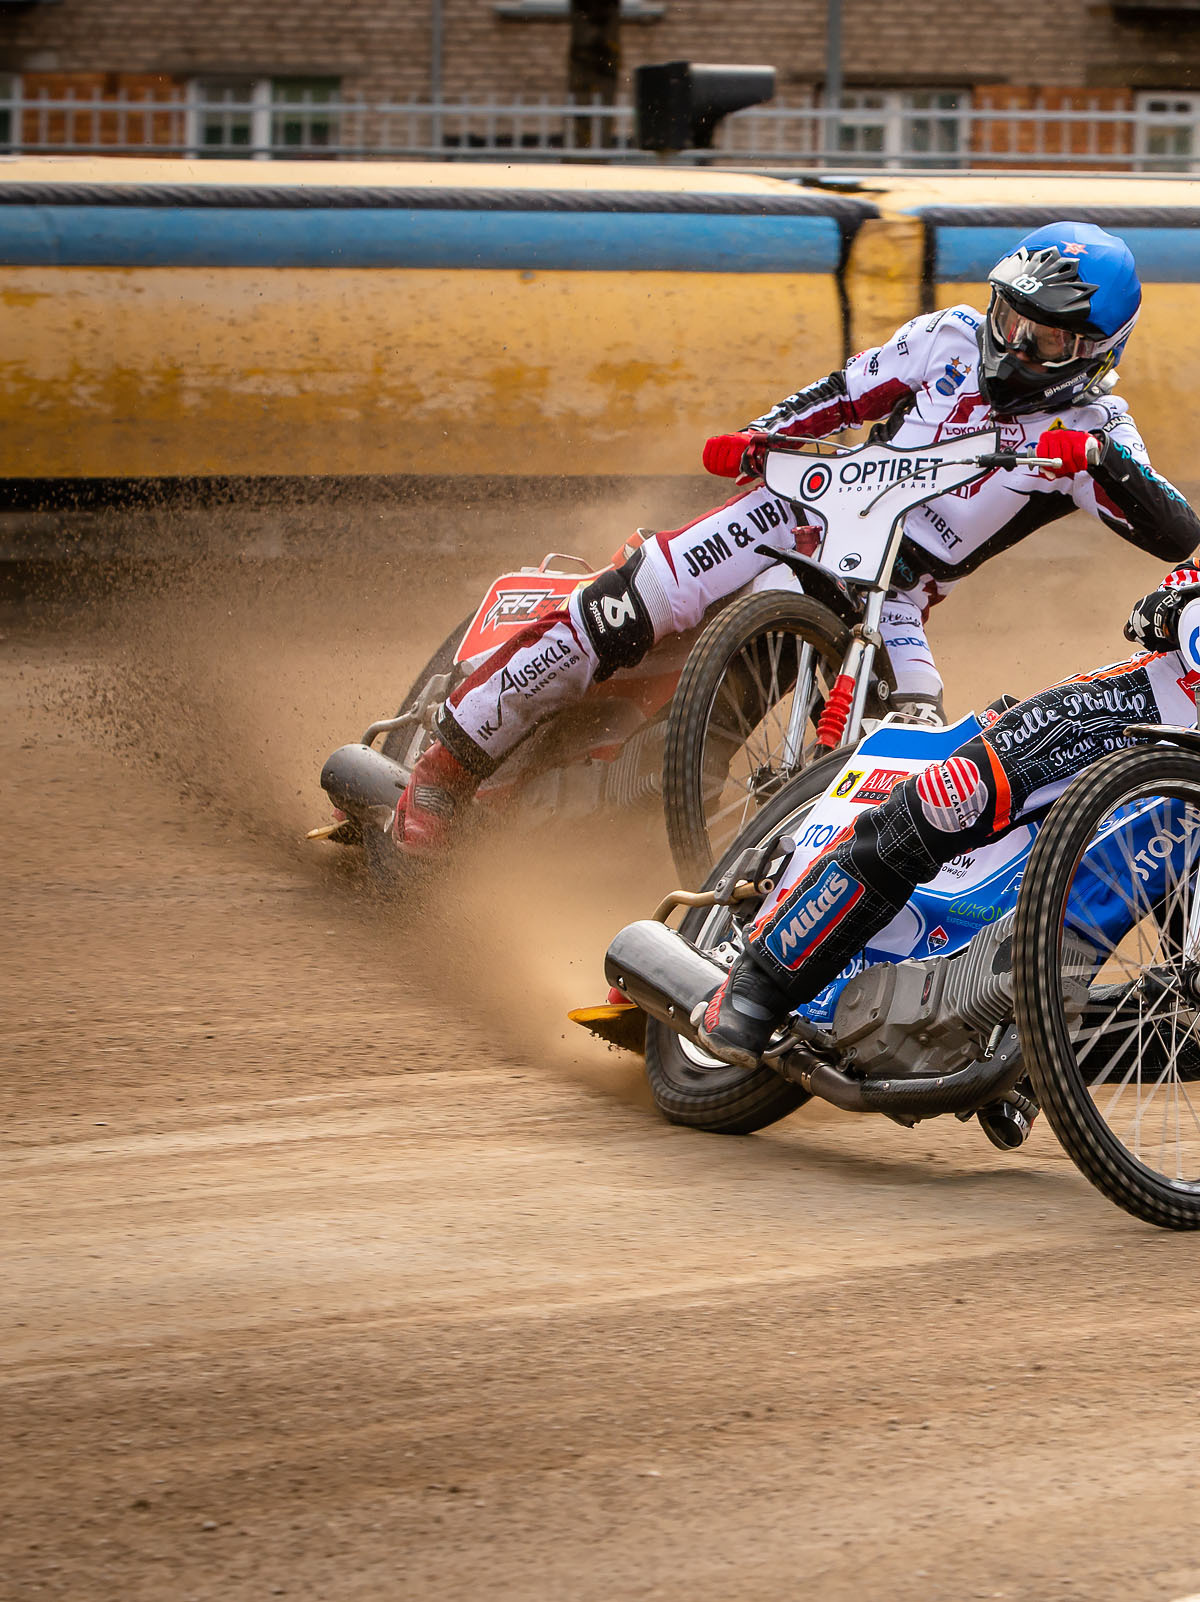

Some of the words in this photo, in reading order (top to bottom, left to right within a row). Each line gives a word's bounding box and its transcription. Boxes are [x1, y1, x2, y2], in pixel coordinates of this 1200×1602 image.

[839, 457, 943, 484] OPTIBET
[920, 503, 963, 550] TIBET
[682, 532, 733, 578] JBM
[727, 522, 756, 548] &
[589, 600, 606, 634] Systems
[523, 671, 557, 700] ANNO
[559, 654, 581, 672] 1989
[476, 719, 499, 741] IK
[995, 706, 1063, 752] Palle
[1063, 687, 1147, 718] Phillip
[797, 823, 841, 848] STOL
[941, 865, 968, 880] owacji
[779, 872, 849, 959] Mitas
[948, 899, 1014, 922] LUXION
